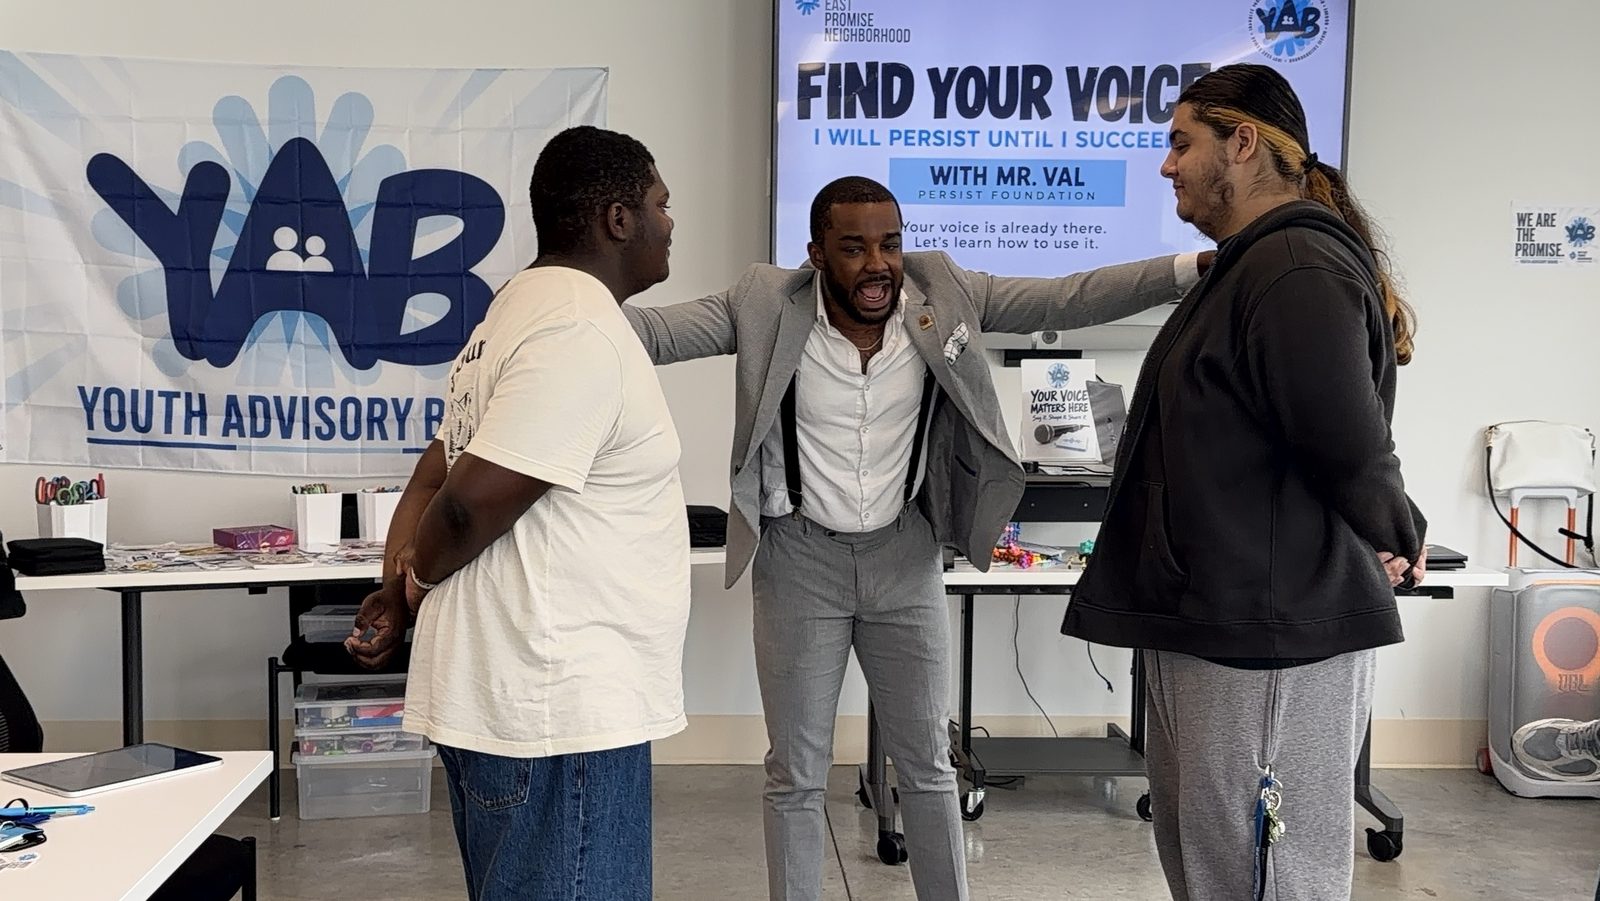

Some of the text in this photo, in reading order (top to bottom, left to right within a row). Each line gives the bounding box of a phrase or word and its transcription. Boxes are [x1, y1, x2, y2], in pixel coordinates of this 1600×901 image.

[825, 0, 851, 11] EAST
[824, 13, 874, 27] PROMISE
[1256, 0, 1321, 40] YAB
[824, 28, 911, 43] NEIGHBORHOOD
[797, 61, 915, 120] FIND
[926, 64, 1053, 120] YOUR
[814, 128, 1171, 149] I WILL PERSIST UNTIL I SUCCEE
[930, 165, 1085, 187] WITH MR. VAL
[918, 190, 1097, 201] PERSIST FOUNDATION
[1516, 213, 1557, 227] WE ARE
[902, 221, 1107, 236] Your voice is already there.
[1516, 228, 1536, 242] THE
[1565, 223, 1596, 241] YAB
[915, 236, 1099, 249] Let's learn how to use it.
[86, 137, 505, 371] YAB
[1515, 243, 1565, 257] PROMISE.
[1030, 389, 1088, 403] YOUR VOICE
[77, 386, 208, 436] YOUTH
[221, 394, 414, 440] ADVISORY
[425, 397, 445, 440] B
[1030, 402, 1089, 414] MATTERS HERE
